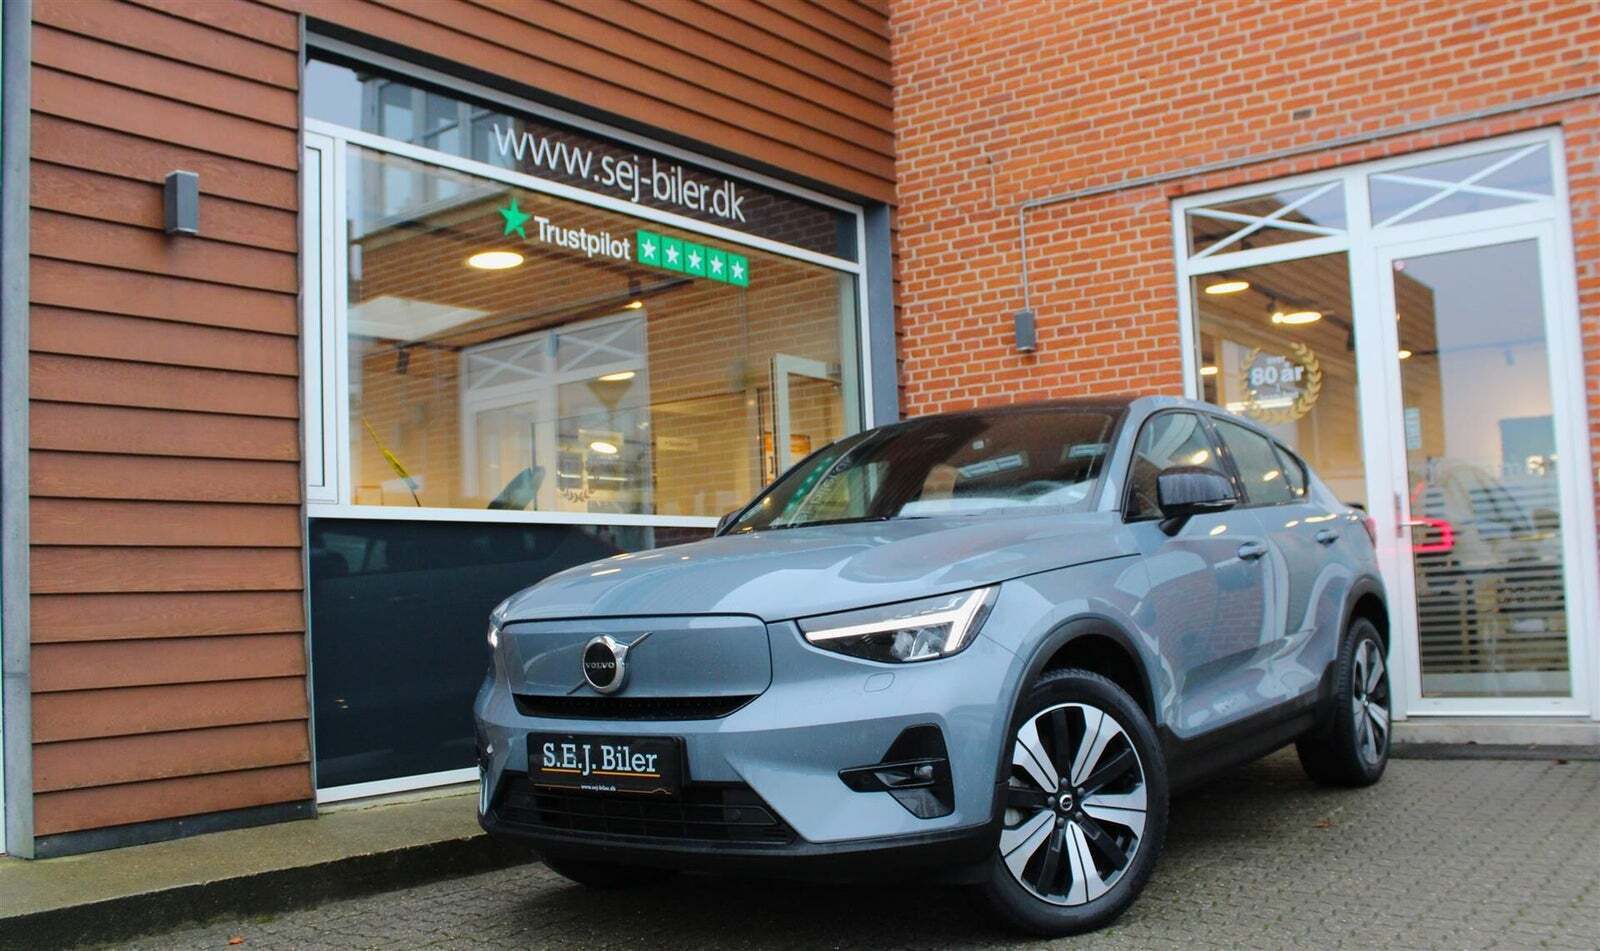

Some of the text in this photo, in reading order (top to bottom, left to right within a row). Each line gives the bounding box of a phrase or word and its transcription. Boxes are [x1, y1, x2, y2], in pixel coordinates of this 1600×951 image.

[493, 123, 745, 222] www.sej-biler.dk
[534, 215, 631, 261] Trustpilot
[1250, 366, 1278, 386] 80
[543, 742, 657, 776] S.E.J. Biler
